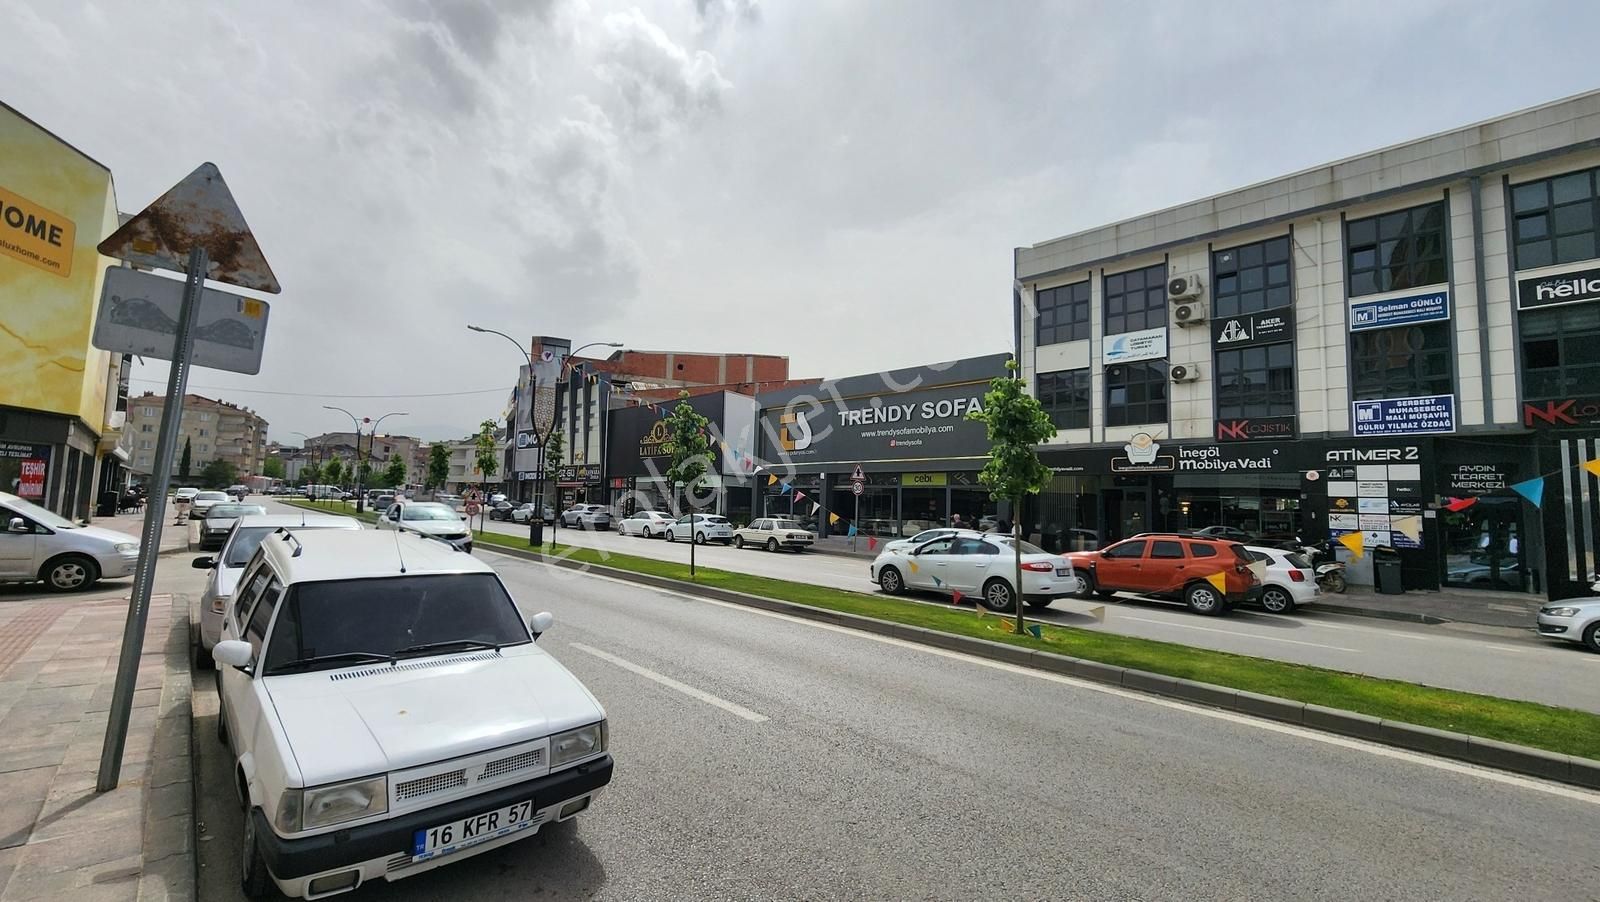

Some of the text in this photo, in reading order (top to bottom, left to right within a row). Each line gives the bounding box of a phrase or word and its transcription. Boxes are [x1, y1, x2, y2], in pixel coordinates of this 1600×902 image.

[0, 200, 63, 247] OME
[1378, 296, 1442, 313] Selman GÜNLÜ
[838, 397, 984, 426] TRENDY SOFA
[1396, 399, 1436, 407] SERBEST
[1524, 399, 1577, 426] NK
[861, 424, 954, 438] www.trendysofamobilya.com
[1218, 420, 1249, 440] NK
[1388, 422, 1418, 430] YILMAZ
[1421, 419, 1451, 428] ÖZDAĞ
[1326, 447, 1419, 461] ATİMER 2
[21, 460, 46, 478] TEŞHİR
[1238, 457, 1272, 469] Vadi
[1451, 481, 1505, 489] MERKEZİ
[430, 825, 453, 848] 16
[462, 812, 499, 839] KFR
[508, 802, 531, 824] 57
